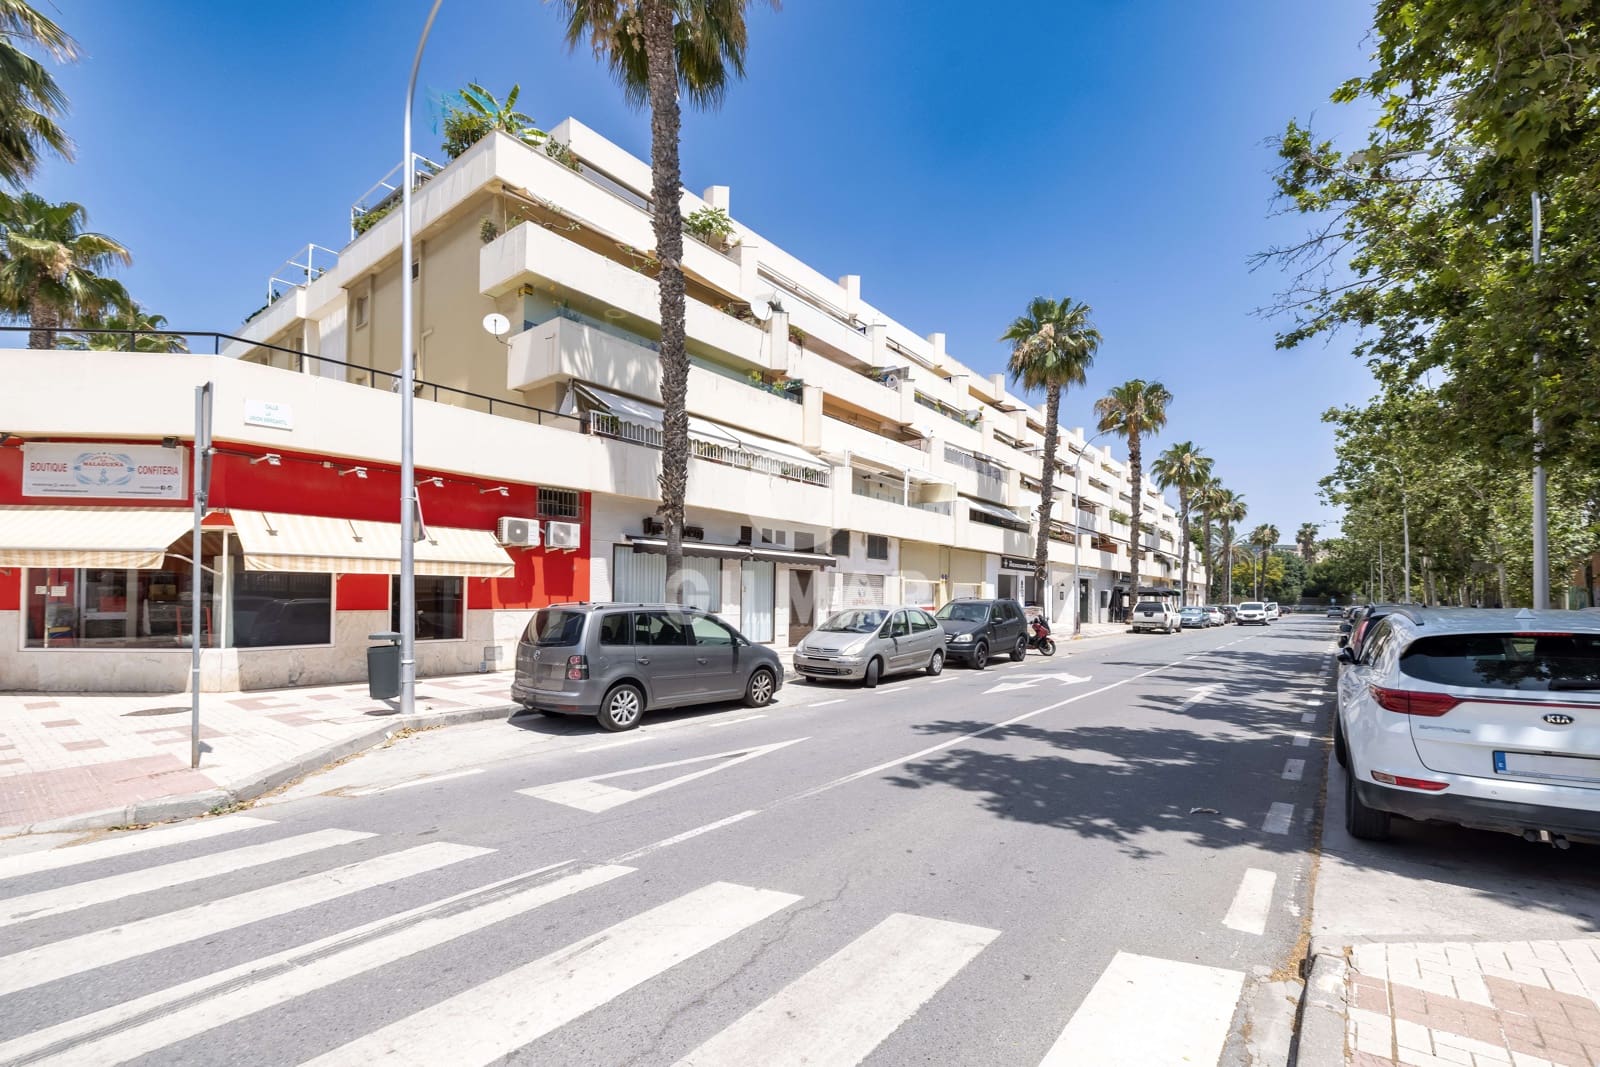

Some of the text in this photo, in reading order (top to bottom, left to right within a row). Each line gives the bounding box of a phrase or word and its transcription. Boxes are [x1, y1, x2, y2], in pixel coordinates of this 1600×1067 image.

[30, 462, 68, 472] BOUTIQUE
[137, 465, 179, 475] CONFITERIA
[1546, 714, 1571, 724] KIA
